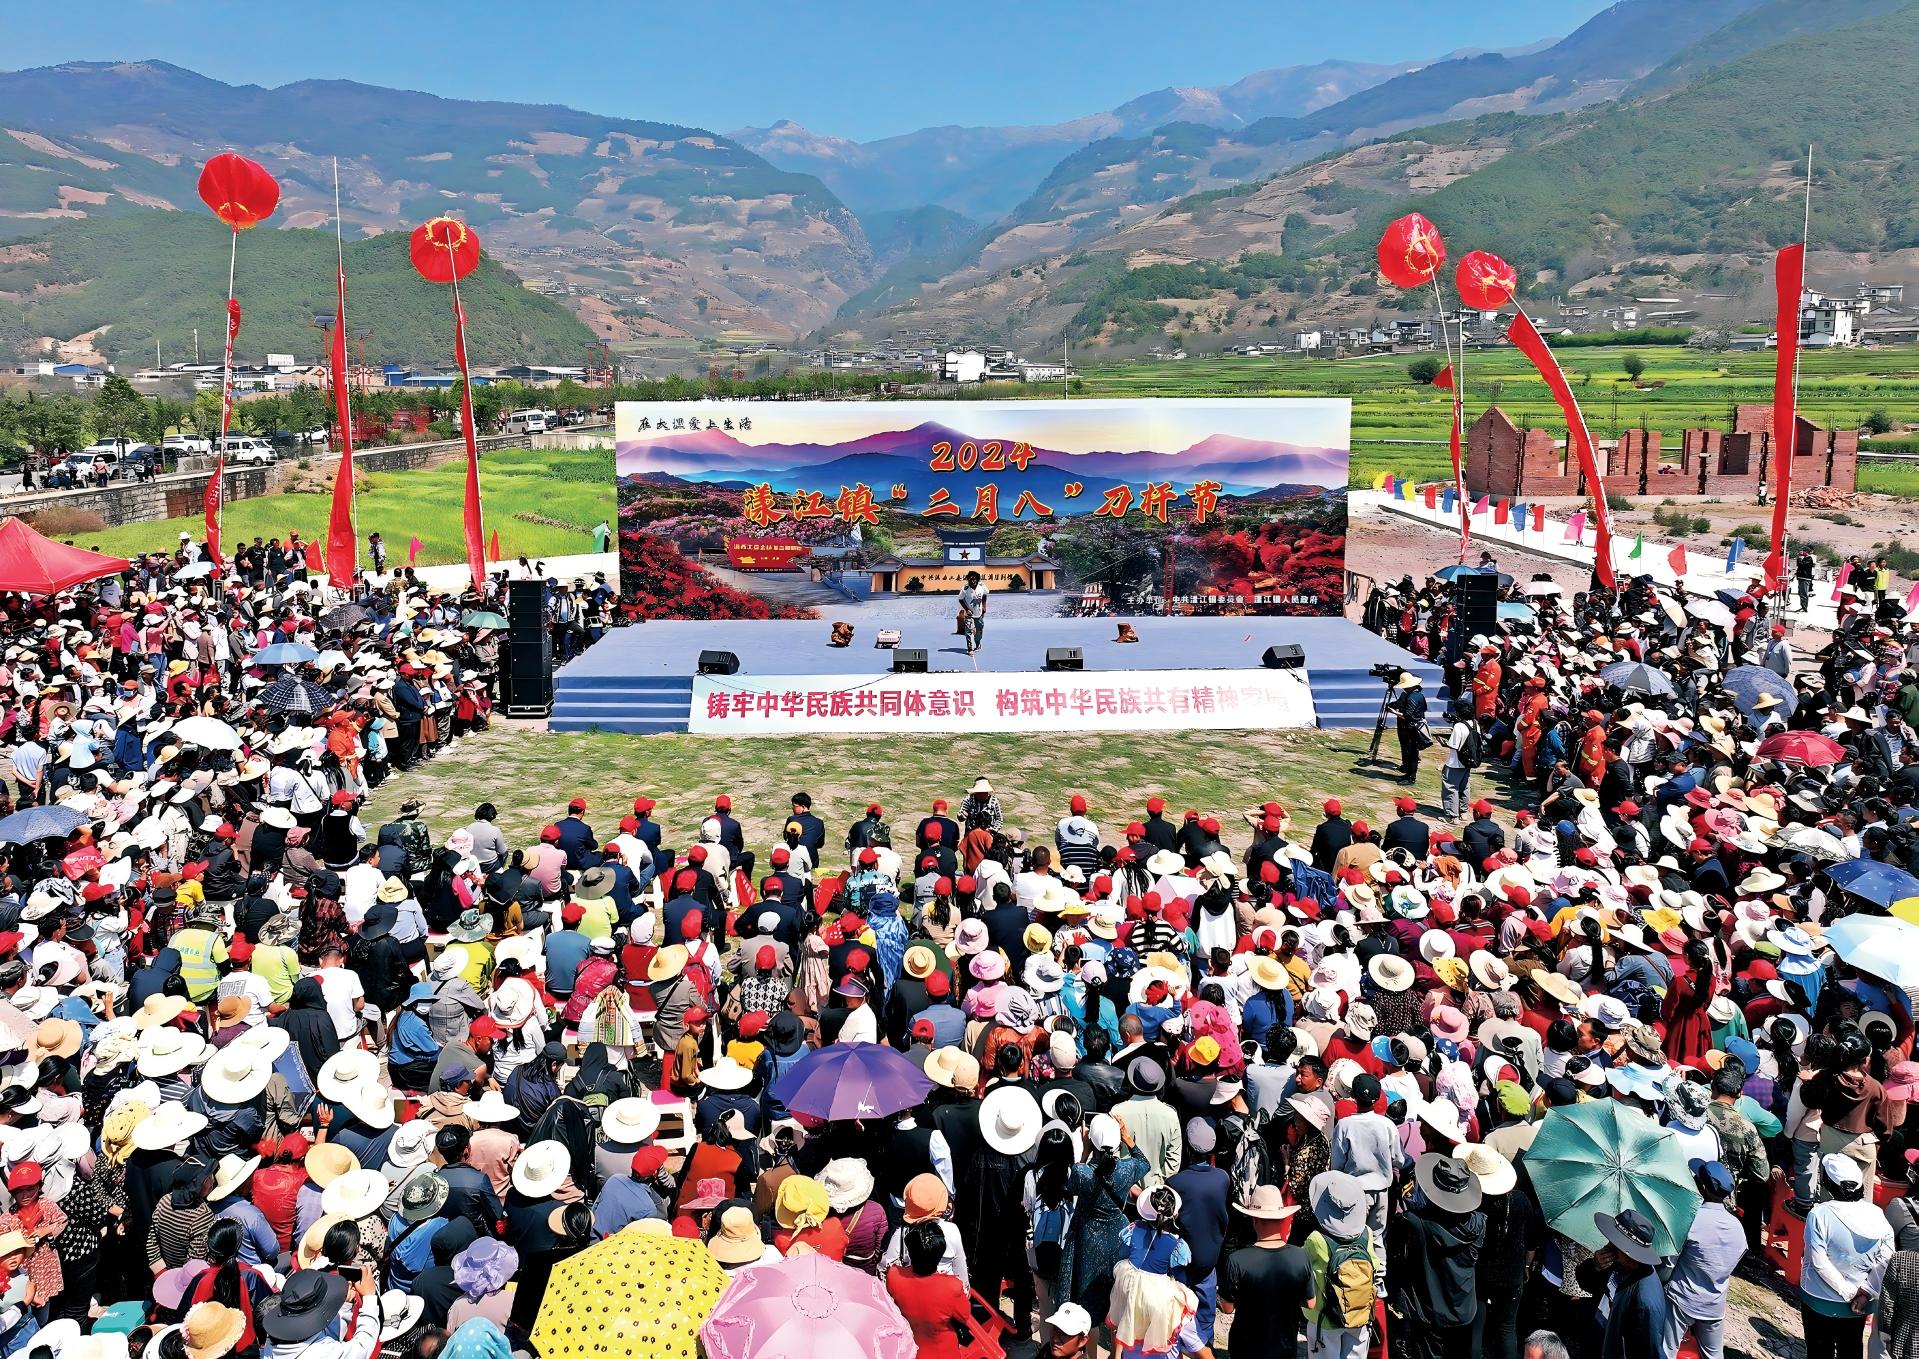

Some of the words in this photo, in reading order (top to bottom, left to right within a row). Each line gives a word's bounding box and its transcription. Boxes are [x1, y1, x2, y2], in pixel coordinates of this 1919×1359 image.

[929, 441, 1036, 472] 2024
[706, 689, 976, 719] 铸牢中华民族共同体意识
